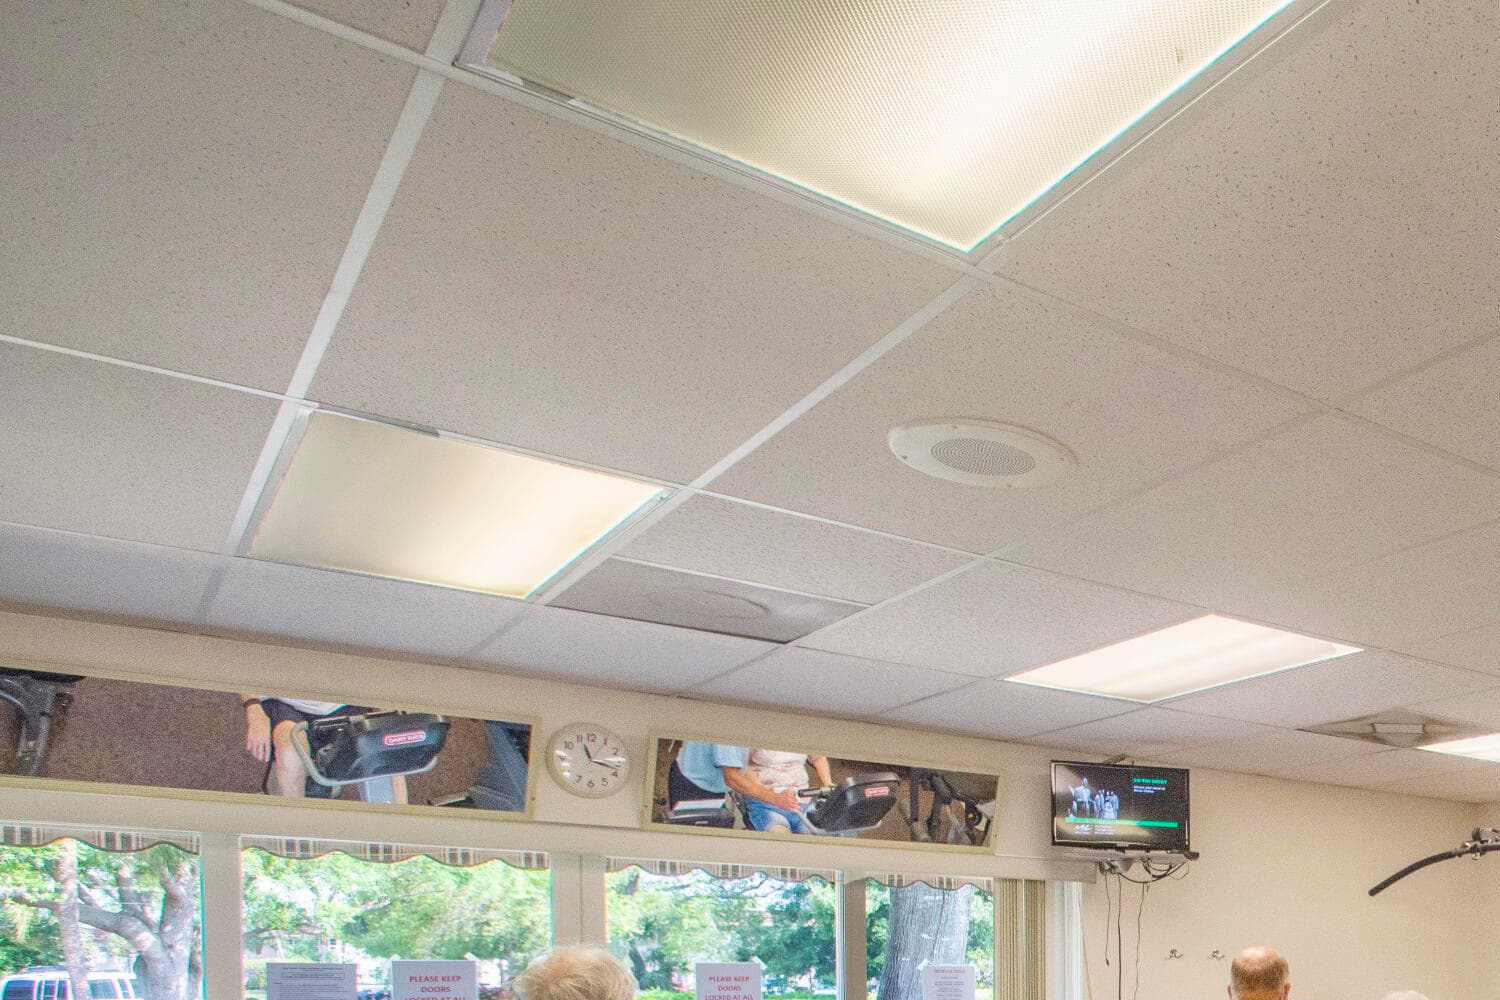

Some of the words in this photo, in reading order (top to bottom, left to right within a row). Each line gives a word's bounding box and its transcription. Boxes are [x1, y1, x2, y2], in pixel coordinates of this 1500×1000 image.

[576, 734, 583, 743] 11
[586, 733, 597, 743] 12
[564, 741, 574, 750] 10
[611, 747, 619, 756] 2
[576, 775, 583, 783] 7
[587, 779, 595, 788] 6
[601, 778, 608, 787] 5
[408, 975, 439, 983] PLEASE
